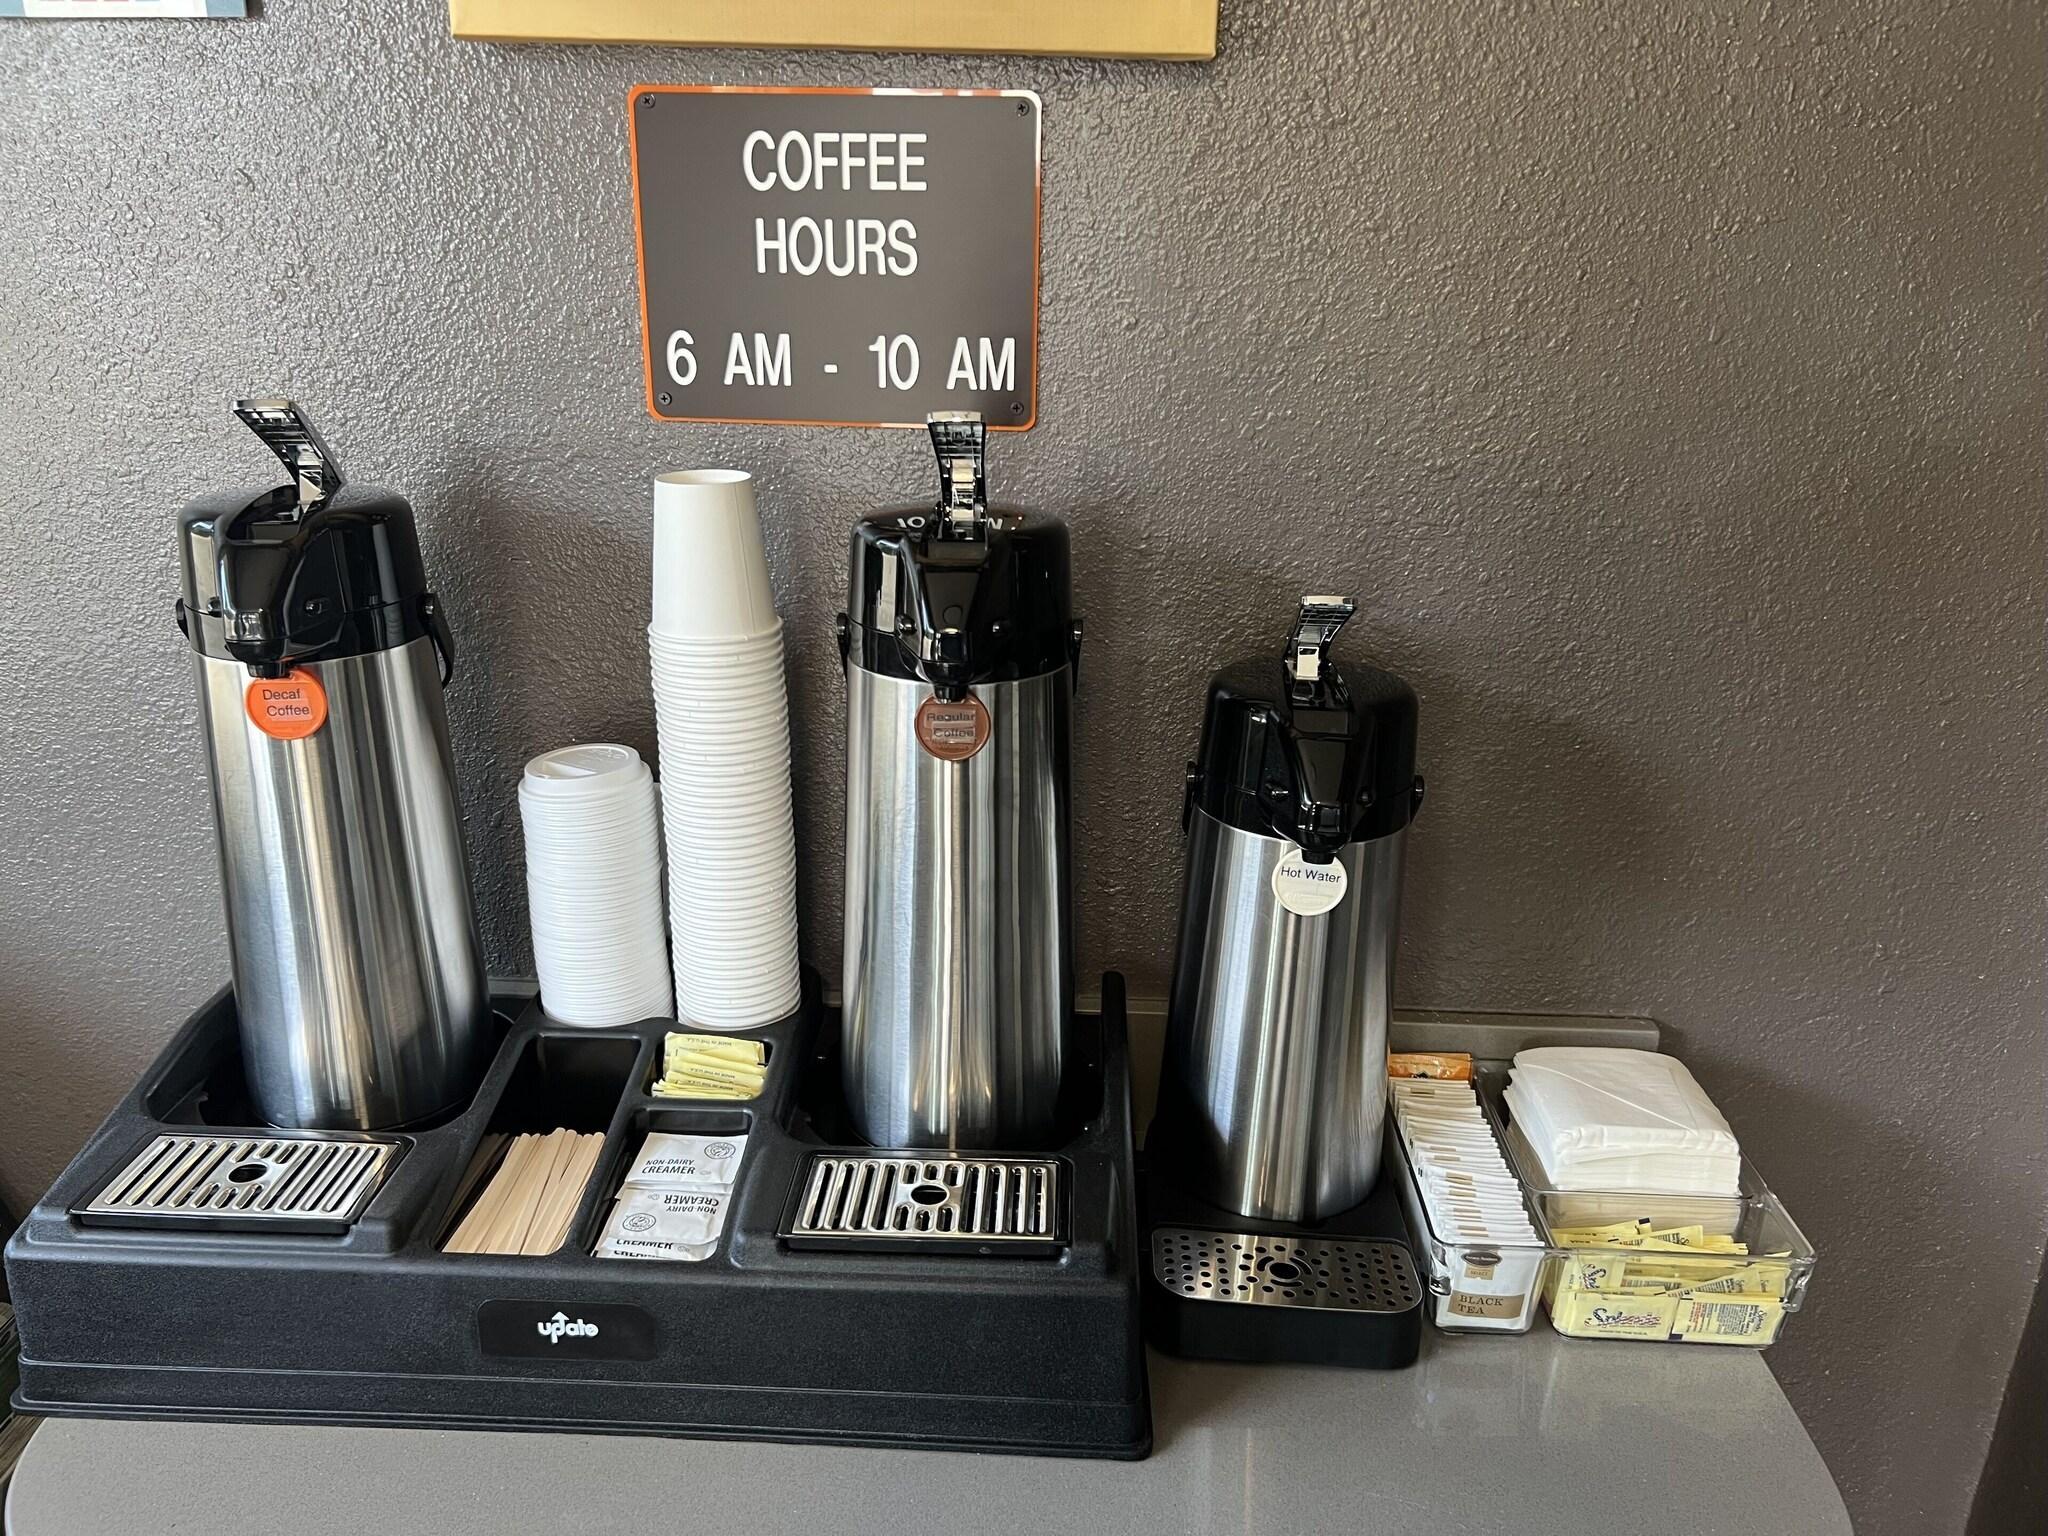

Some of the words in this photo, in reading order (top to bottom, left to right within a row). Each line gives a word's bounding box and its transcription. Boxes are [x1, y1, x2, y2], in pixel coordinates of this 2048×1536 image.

[743, 130, 928, 191] COFFEE
[755, 216, 918, 277] HOURS
[666, 329, 698, 385] 6
[724, 332, 792, 386] AM
[824, 364, 838, 373] -
[869, 334, 920, 391] 10
[946, 336, 1015, 391] AM
[262, 688, 301, 700] Decaf
[267, 705, 310, 716] Coffee
[926, 712, 976, 721] Regular
[933, 728, 974, 737] Coffee
[1281, 866, 1301, 878] Hot
[1305, 869, 1341, 883] Water
[642, 1165, 695, 1174] CREAMER
[664, 1195, 719, 1207] CREAMER
[666, 1206, 717, 1214] NON-DAIRY
[1460, 1295, 1503, 1306] BLACK
[1458, 1303, 1484, 1314] TEA
[537, 1311, 599, 1343] update
